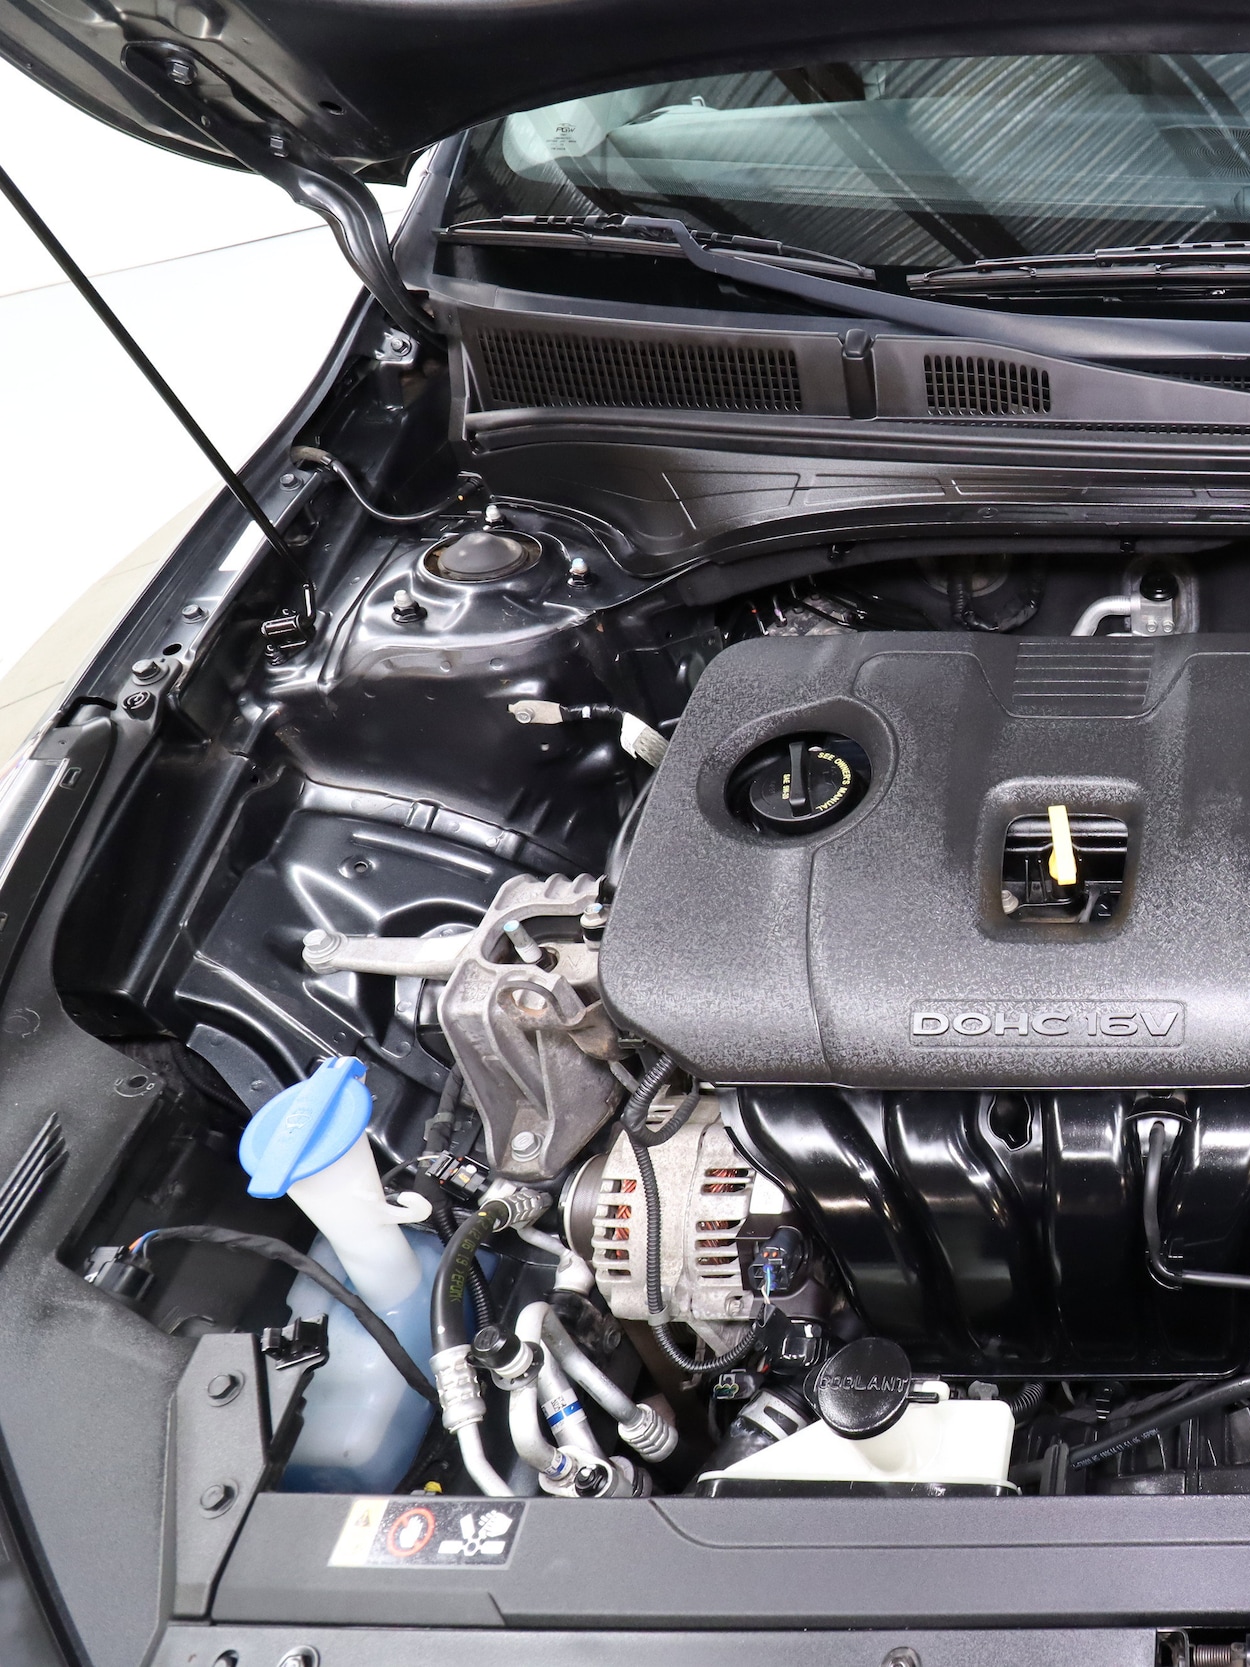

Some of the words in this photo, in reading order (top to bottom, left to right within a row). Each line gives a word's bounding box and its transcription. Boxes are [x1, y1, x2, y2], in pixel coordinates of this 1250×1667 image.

[817, 752, 835, 761] SEE
[815, 786, 848, 811] MANUAL
[912, 1011, 1070, 1037] DOHC
[1084, 1011, 1180, 1037] 16V
[818, 1374, 909, 1393] COOLANT
